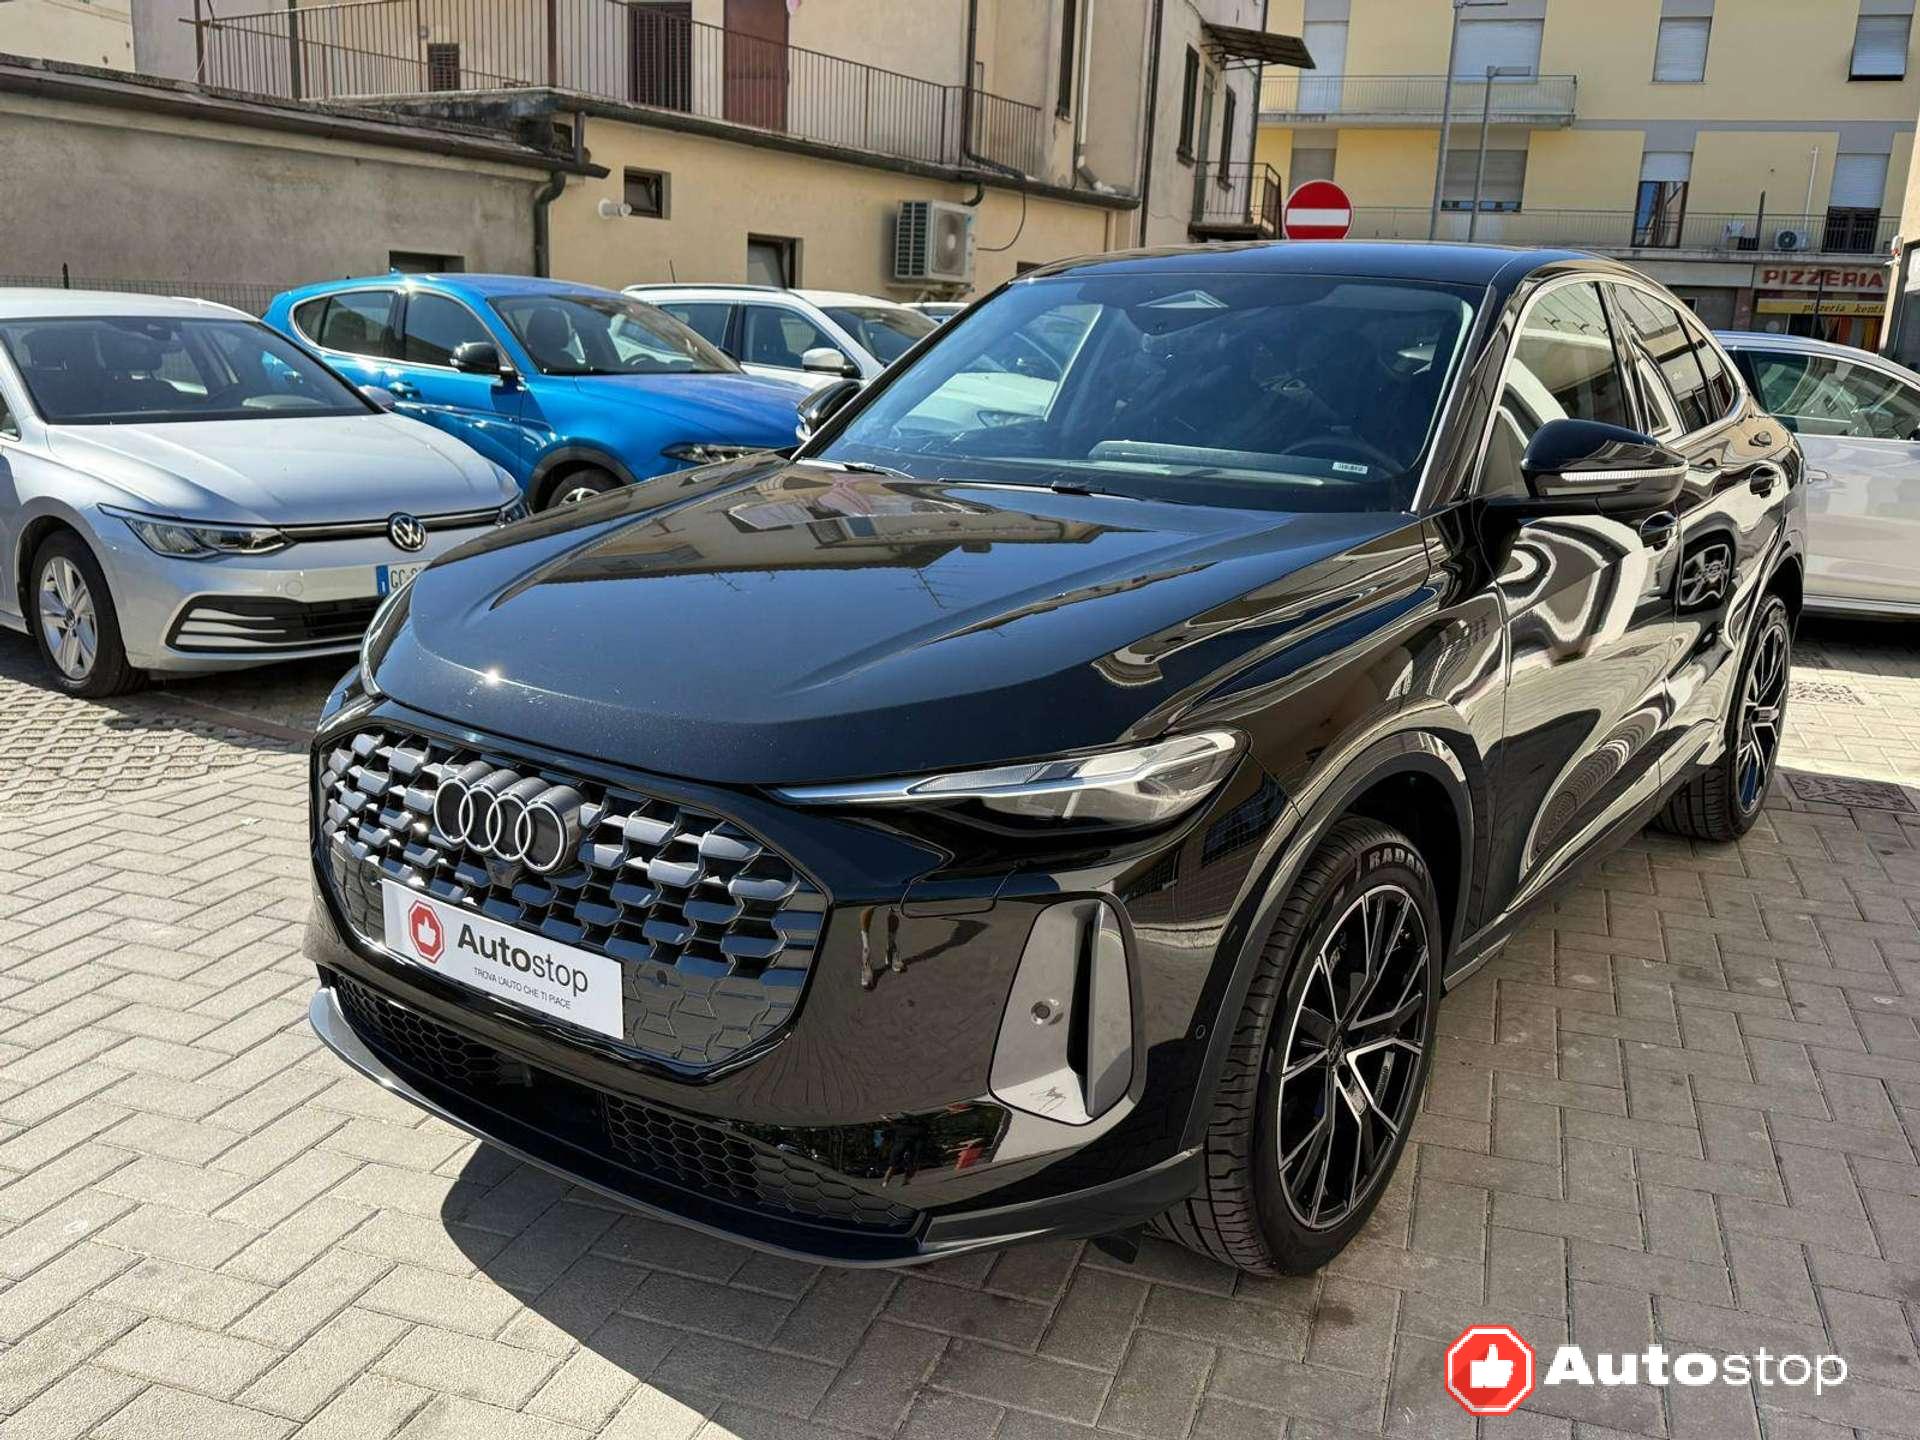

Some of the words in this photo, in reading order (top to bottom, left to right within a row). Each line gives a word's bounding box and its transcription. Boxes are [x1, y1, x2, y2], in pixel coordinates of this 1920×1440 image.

[1763, 269, 1884, 288] PIZZERIA
[457, 923, 588, 997] Autostop
[474, 967, 497, 983] TROVA
[498, 975, 522, 992] L'AUTO
[524, 984, 540, 998] CHE
[540, 989, 548, 1001] TI
[549, 994, 571, 1010] PIACE
